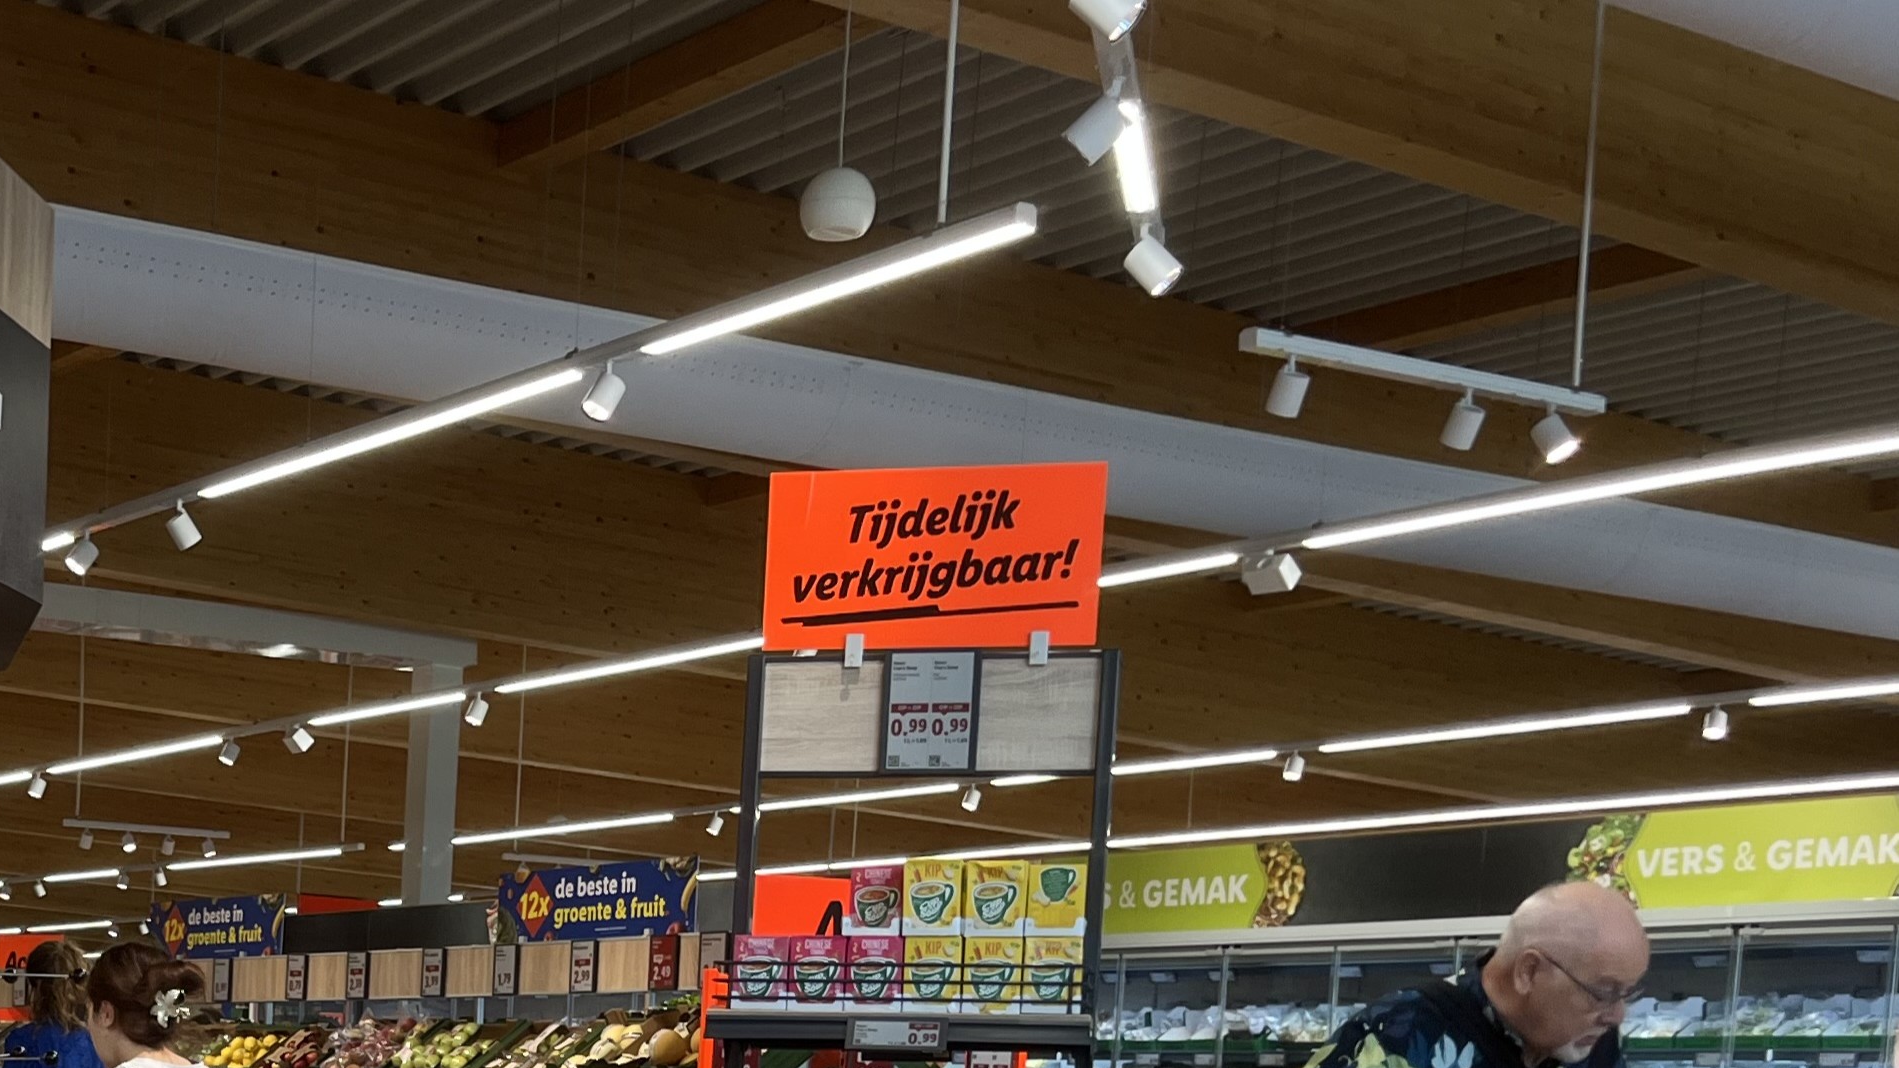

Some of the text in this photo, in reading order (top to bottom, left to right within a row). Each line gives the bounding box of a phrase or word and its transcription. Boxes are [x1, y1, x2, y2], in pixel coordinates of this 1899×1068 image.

[849, 489, 1020, 549] Tijdelijk
[793, 538, 1080, 604] verkrijgbaar!
[1637, 832, 1899, 878] VERS & GEMAK
[924, 863, 942, 878] KIP
[555, 871, 637, 899] de beste in
[1119, 879, 1136, 909] &
[1143, 874, 1249, 908] GEMAK
[188, 904, 243, 926] de beste in
[519, 890, 551, 921] 12x
[554, 902, 612, 929] groente
[615, 898, 627, 920] &
[164, 920, 186, 943] 12x
[186, 928, 227, 949] groente
[228, 928, 237, 943] &
[925, 941, 942, 955] KIP
[985, 942, 1002, 956] KIP
[652, 965, 671, 982] 2.49
